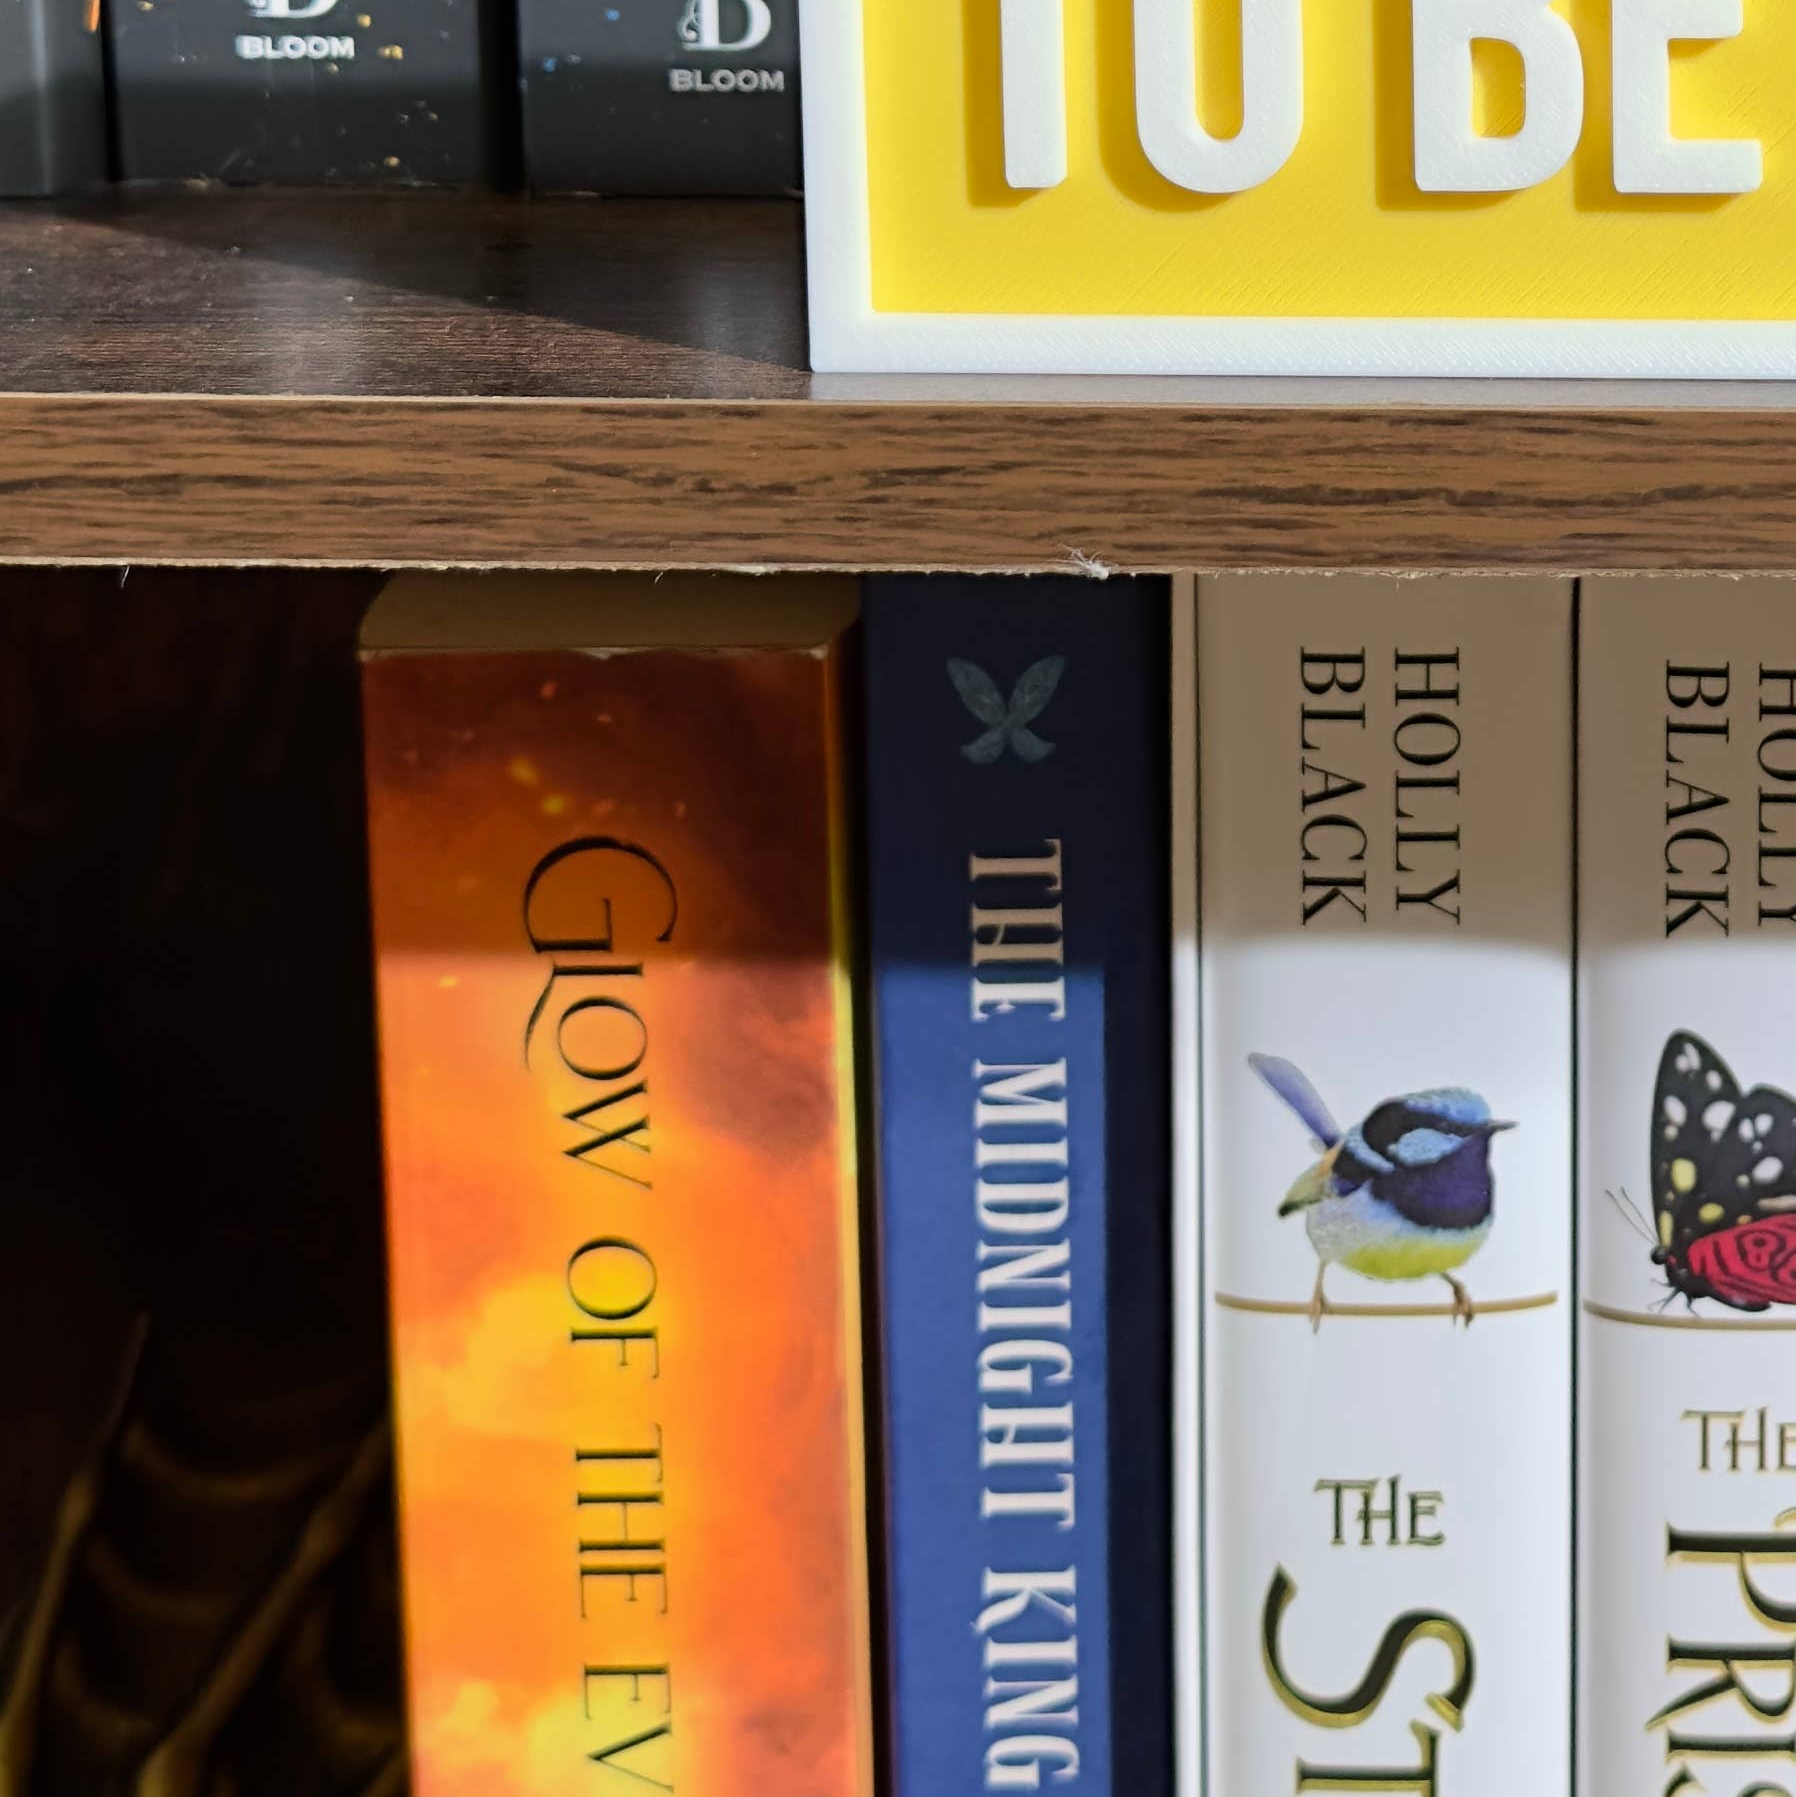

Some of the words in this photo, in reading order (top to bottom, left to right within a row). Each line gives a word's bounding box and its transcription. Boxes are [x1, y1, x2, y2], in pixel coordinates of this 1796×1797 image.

[234, 34, 356, 60] BLOOM
[668, 68, 786, 93] BLOOM
[1298, 646, 1368, 926] BLACK
[1393, 646, 1462, 926] HOLLY
[1663, 659, 1732, 938] BLACK
[522, 834, 680, 1191] GLOW
[970, 837, 1066, 1023] THE
[565, 1235, 660, 1380] OF
[973, 1056, 1078, 1529] MIDNIGHT
[574, 1423, 669, 1620] THE
[1313, 1473, 1446, 1547] THE
[970, 1563, 1081, 1793] KING
